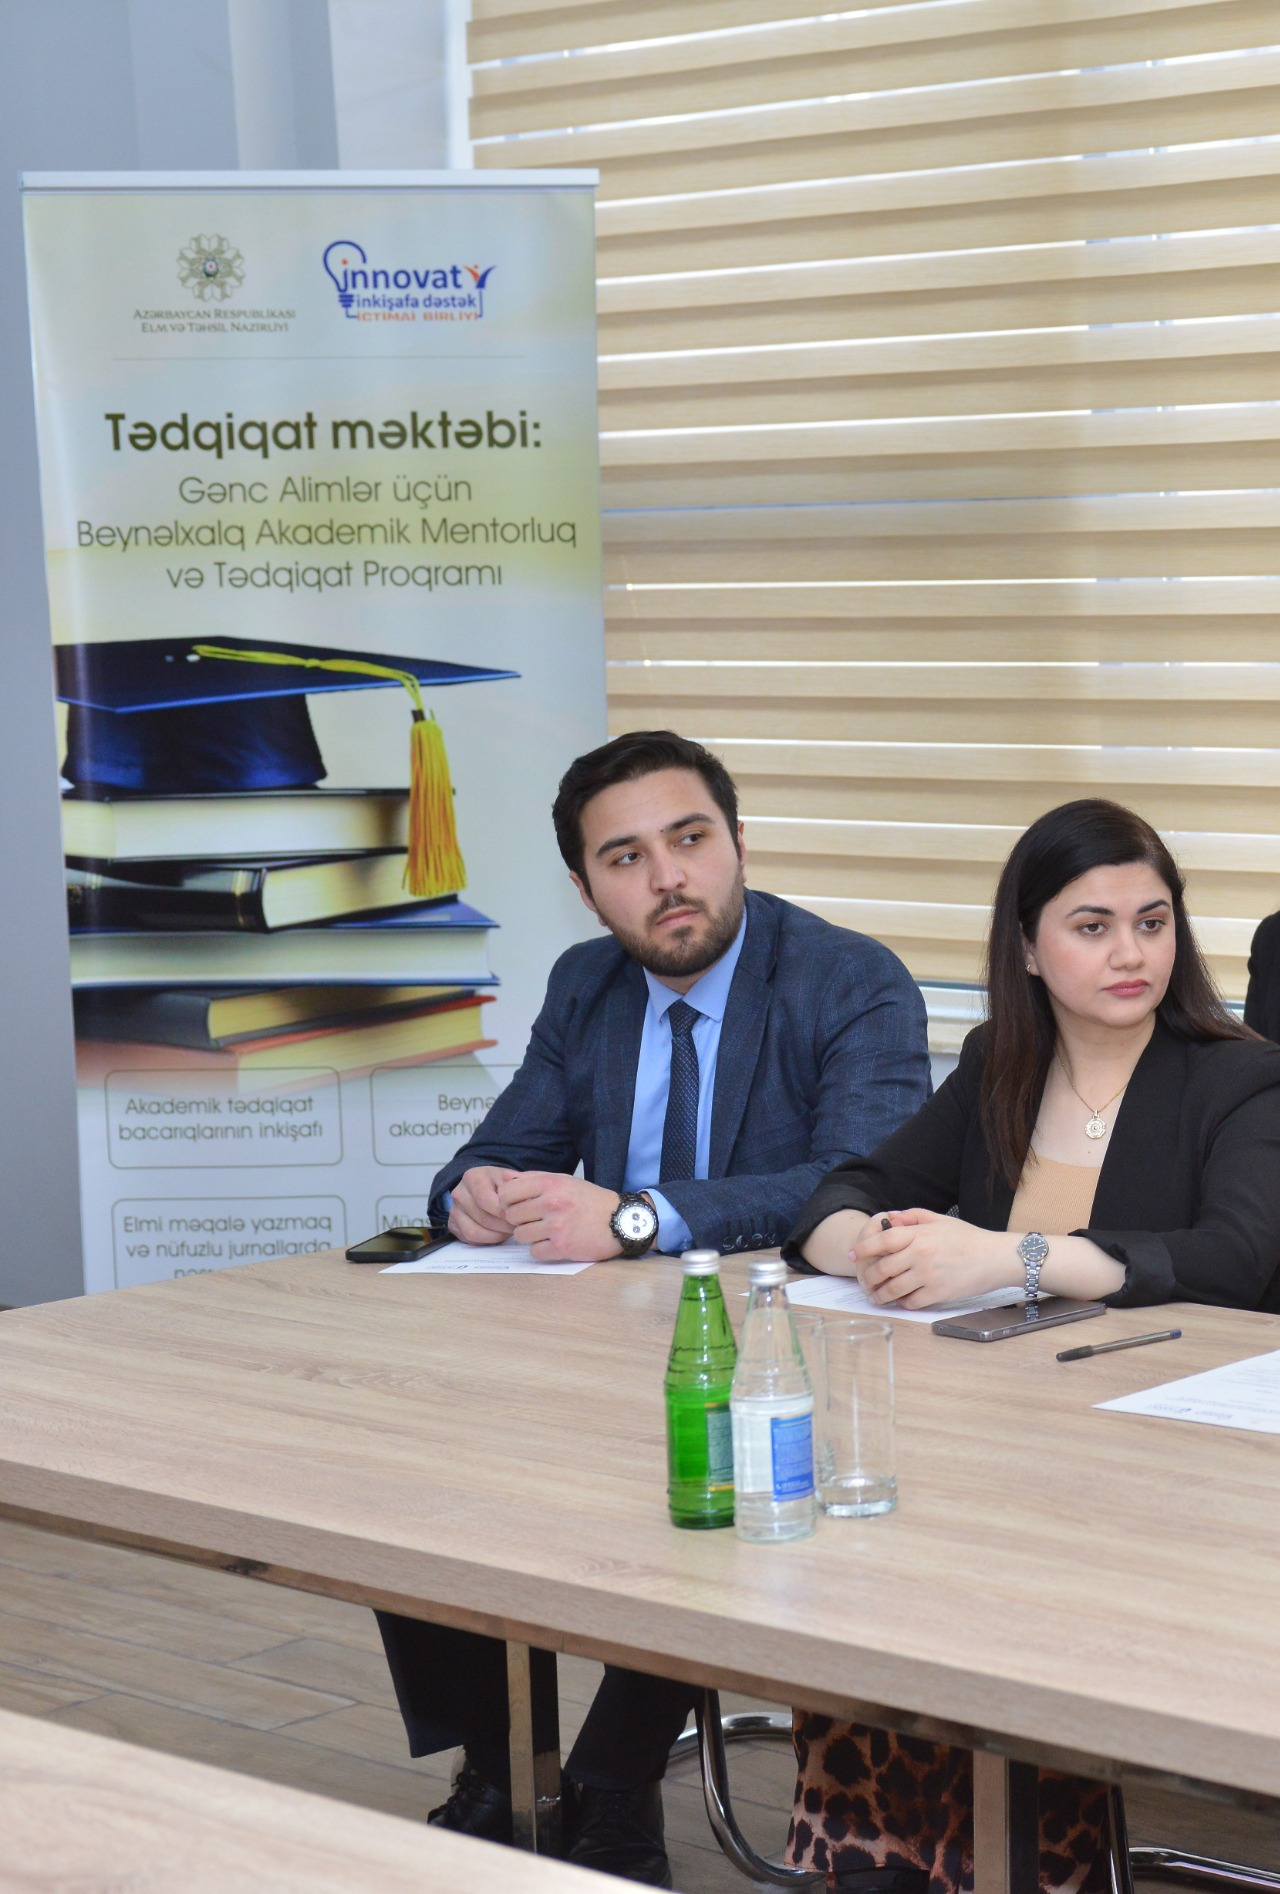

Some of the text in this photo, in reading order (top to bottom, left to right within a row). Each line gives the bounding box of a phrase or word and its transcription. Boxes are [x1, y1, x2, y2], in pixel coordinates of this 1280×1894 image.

[357, 293, 476, 311] inkişafa dəstək
[105, 410, 542, 459] Tədqiqat məktəbi:
[179, 474, 472, 510] Gənc Alimlər üçün
[78, 517, 577, 552] Beynəlxalq Akademik Mentorluq
[166, 560, 502, 594] və Tədqiqat Proqramı
[125, 1096, 314, 1116] Akademik tədqiqat
[124, 1215, 333, 1237] Elmi məqalə yazmaq
[126, 1244, 150, 1258] və
[156, 1240, 223, 1258] nüfuzlu
